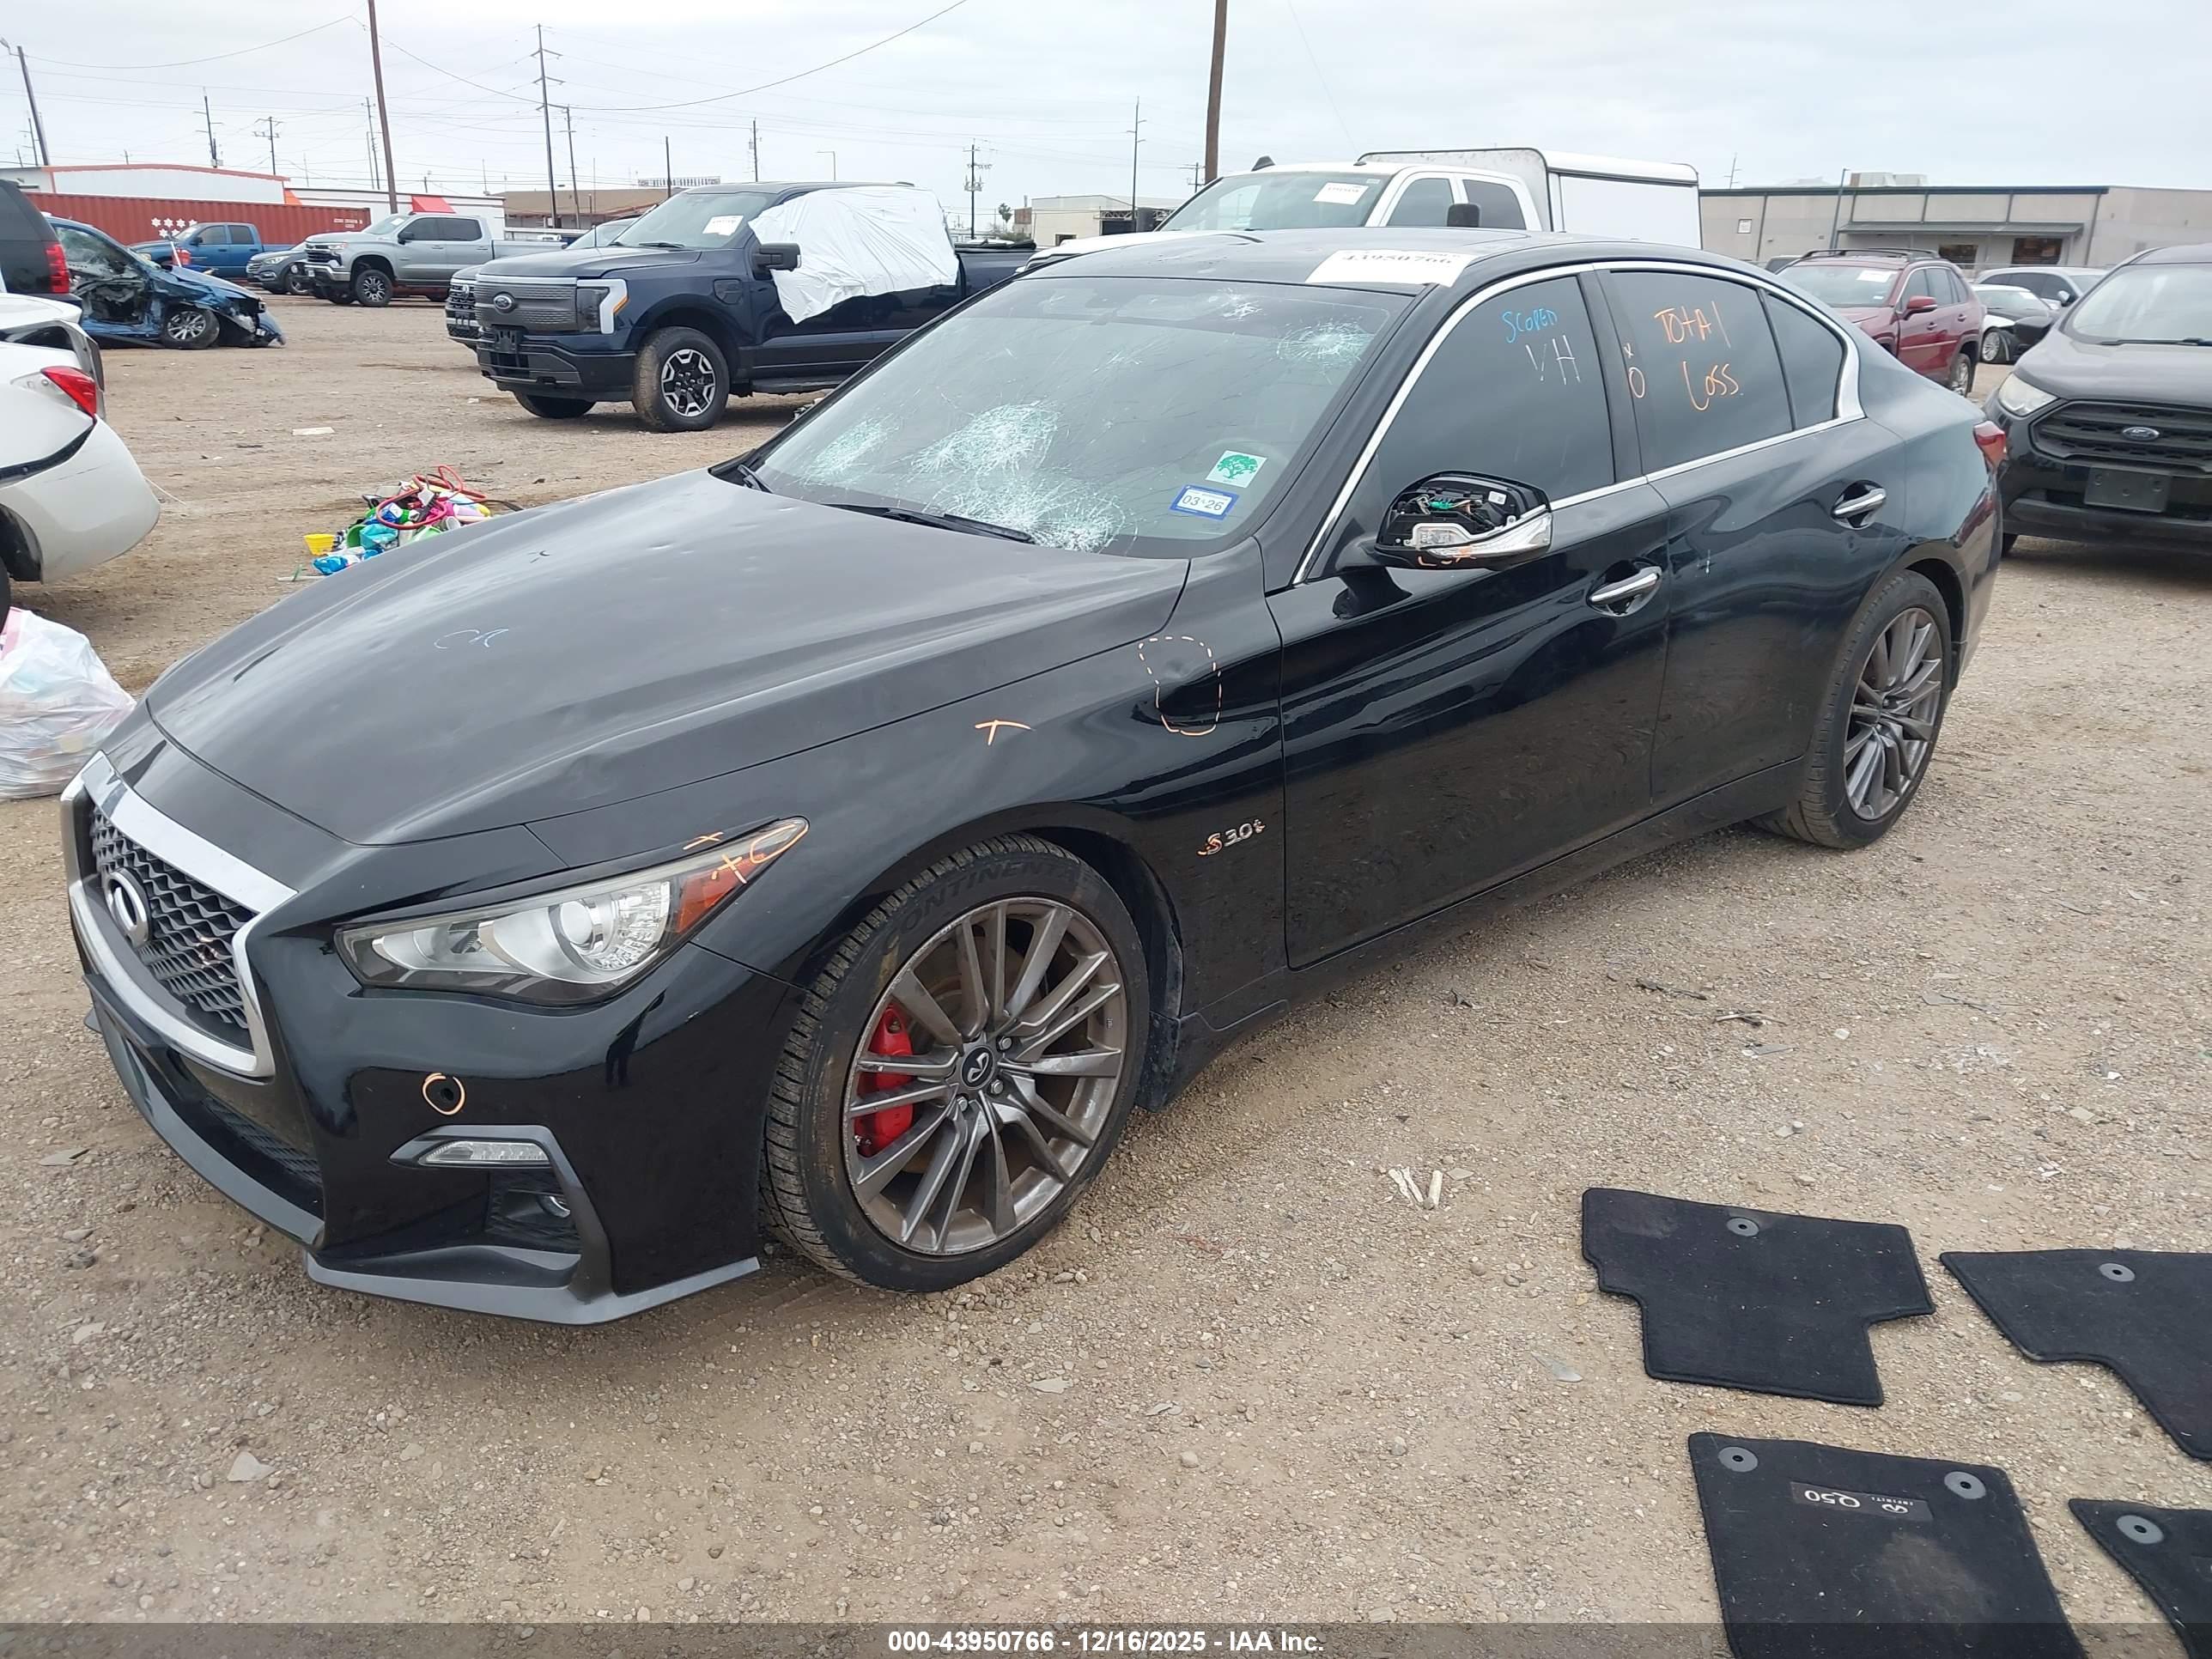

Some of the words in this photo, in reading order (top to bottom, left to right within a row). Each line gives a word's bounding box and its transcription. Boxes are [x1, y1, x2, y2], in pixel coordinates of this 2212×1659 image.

[1182, 495, 1200, 506] 03
[1205, 500, 1224, 511] 26
[1804, 1490, 1860, 1508] Q50
